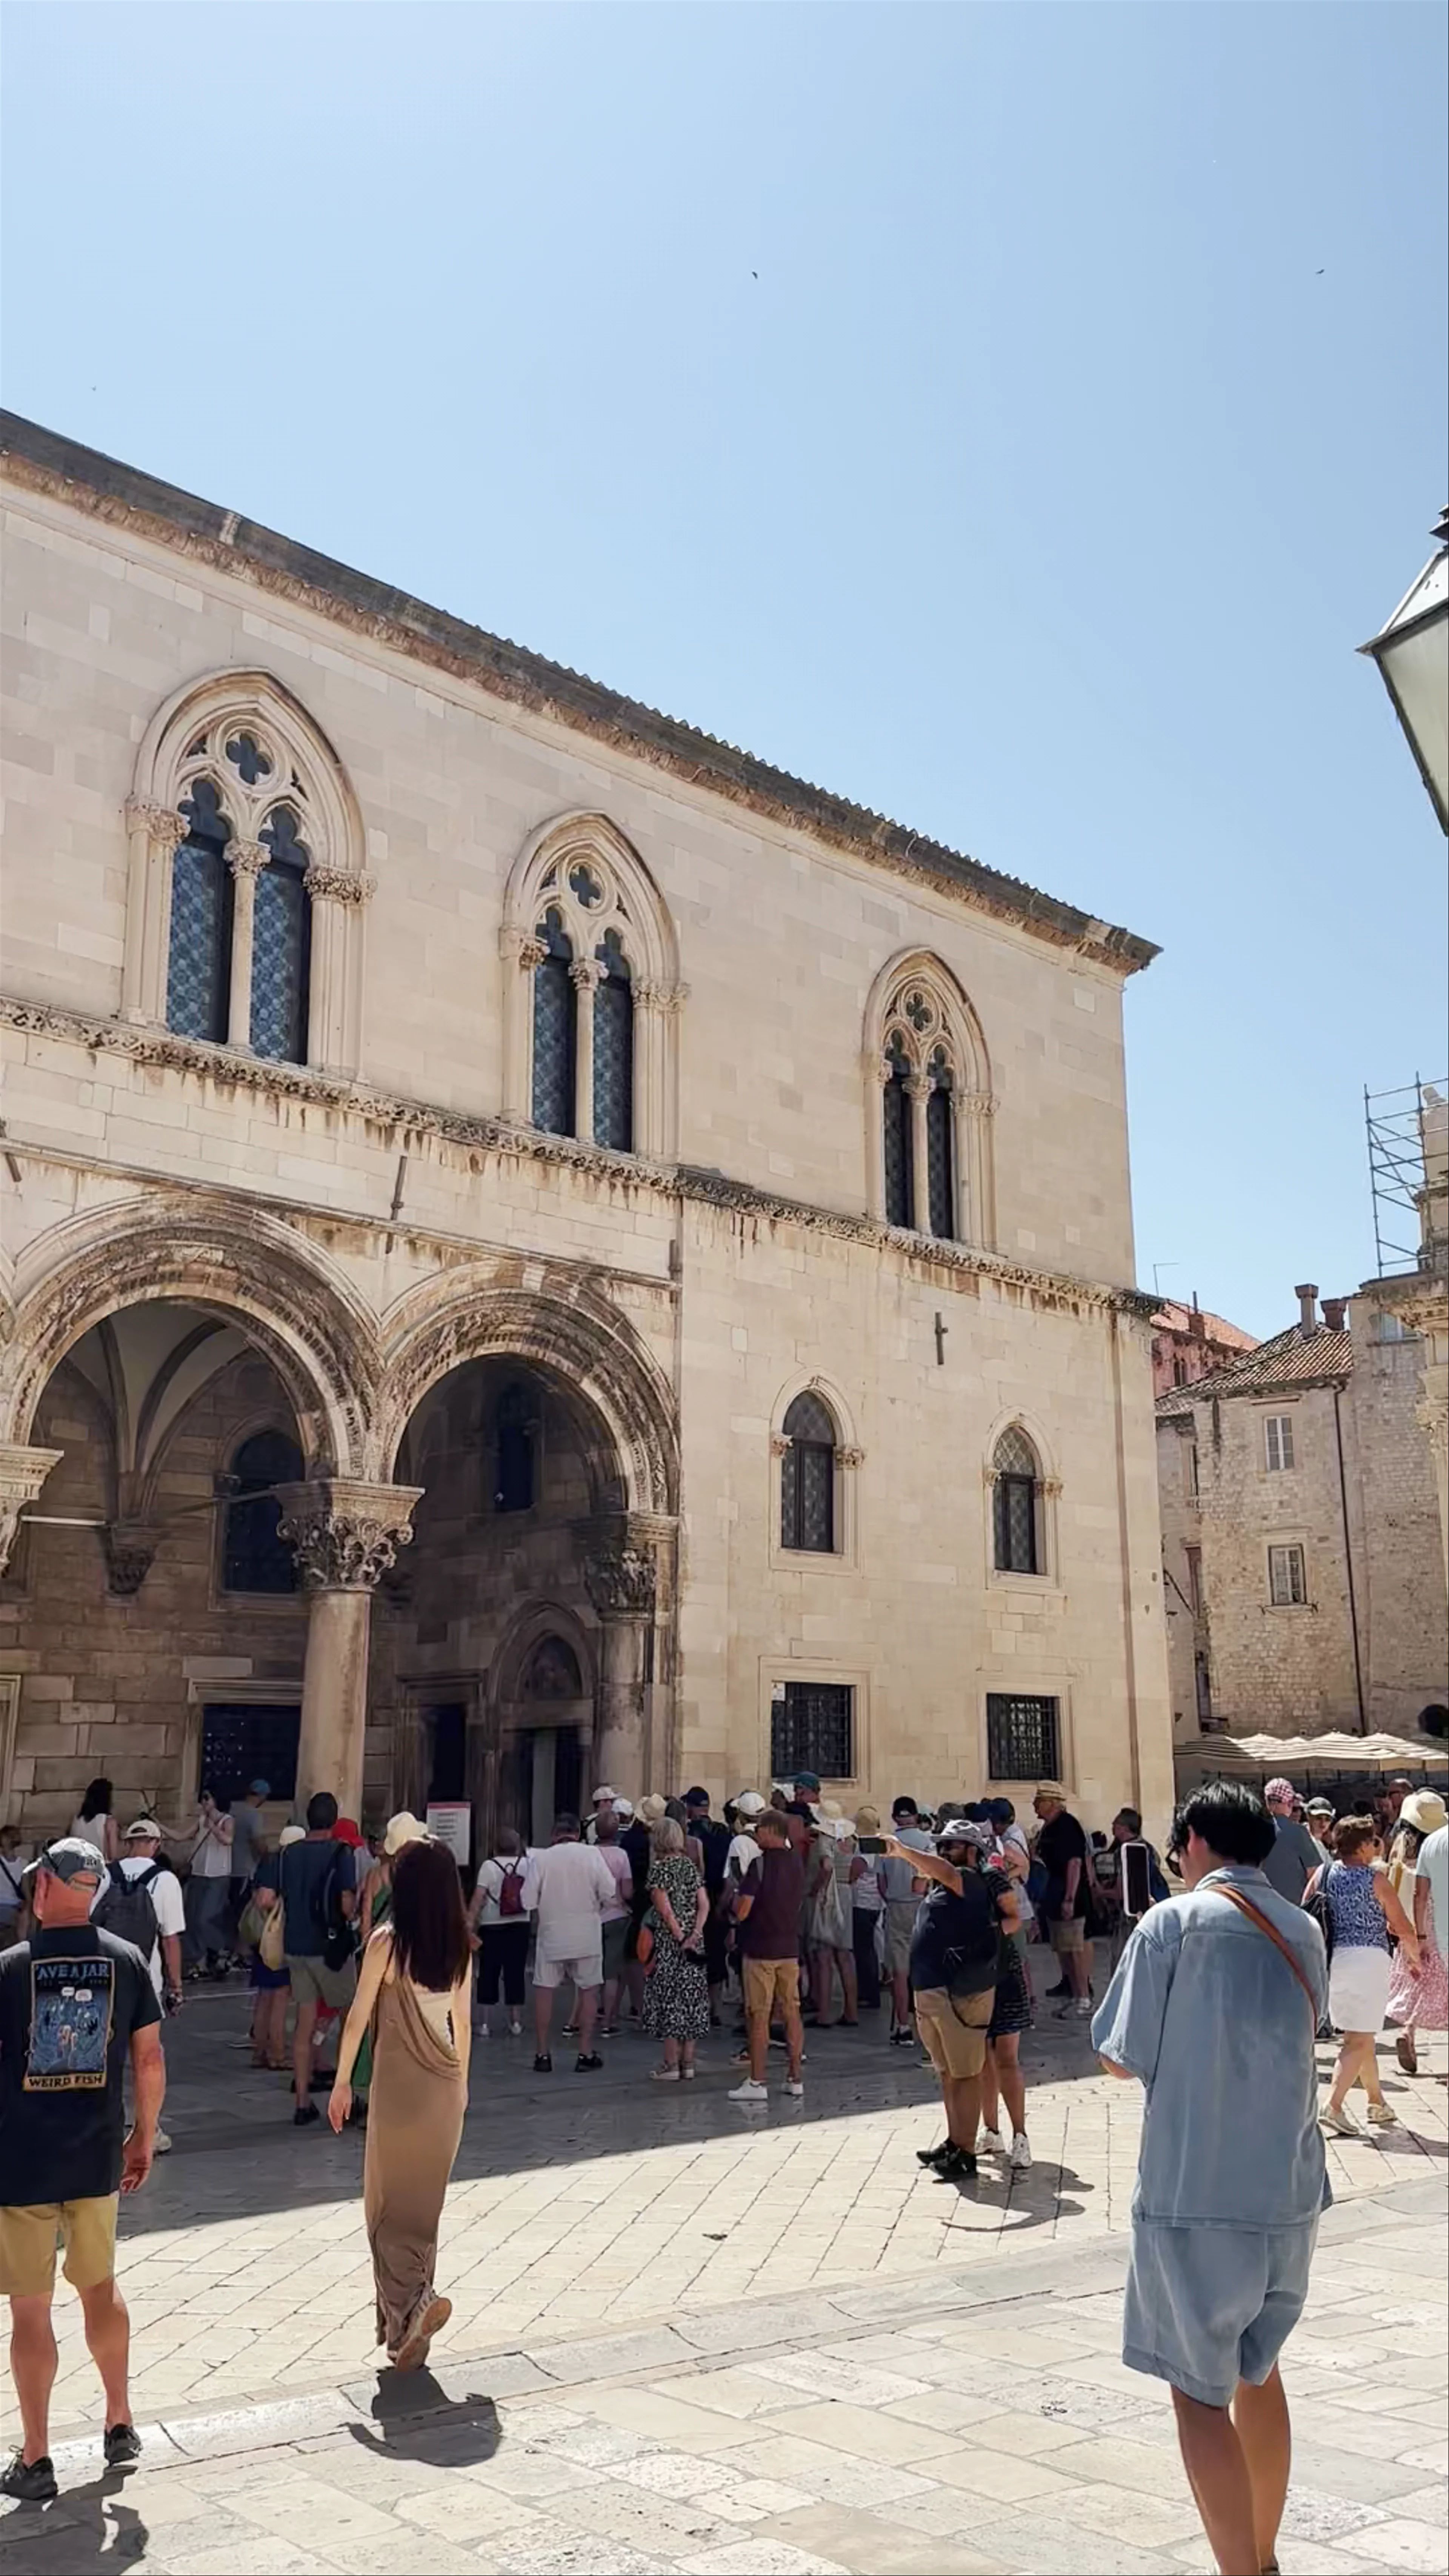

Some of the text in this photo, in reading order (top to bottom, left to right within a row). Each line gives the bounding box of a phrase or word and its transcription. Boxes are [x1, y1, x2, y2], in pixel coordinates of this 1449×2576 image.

[80, 1964, 109, 1980] JAR
[29, 2075, 102, 2087] WEIRD FISH
